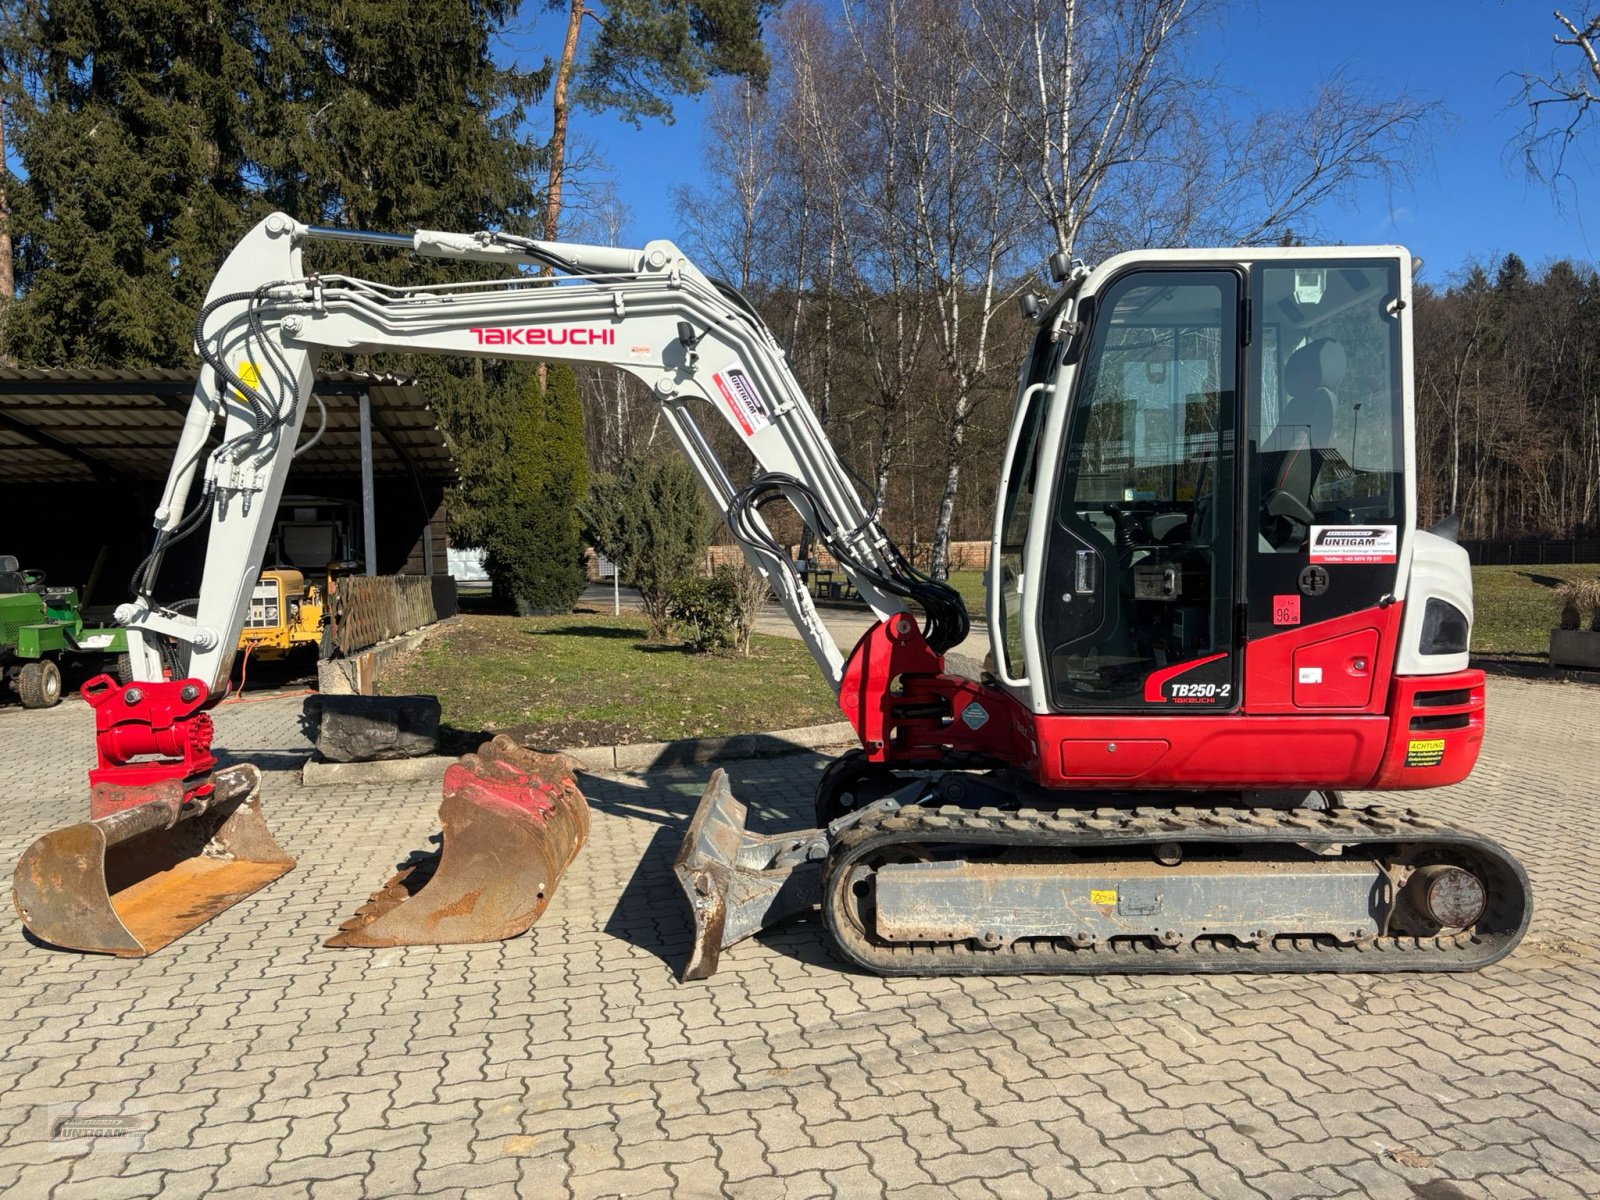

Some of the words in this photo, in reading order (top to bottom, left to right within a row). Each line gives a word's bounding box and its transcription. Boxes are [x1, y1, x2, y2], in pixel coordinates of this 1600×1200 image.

[469, 327, 615, 345] TAKEUCHI
[1277, 608, 1289, 622] 96
[1172, 683, 1231, 697] TB250-2
[1411, 742, 1444, 750] ACHTUNG
